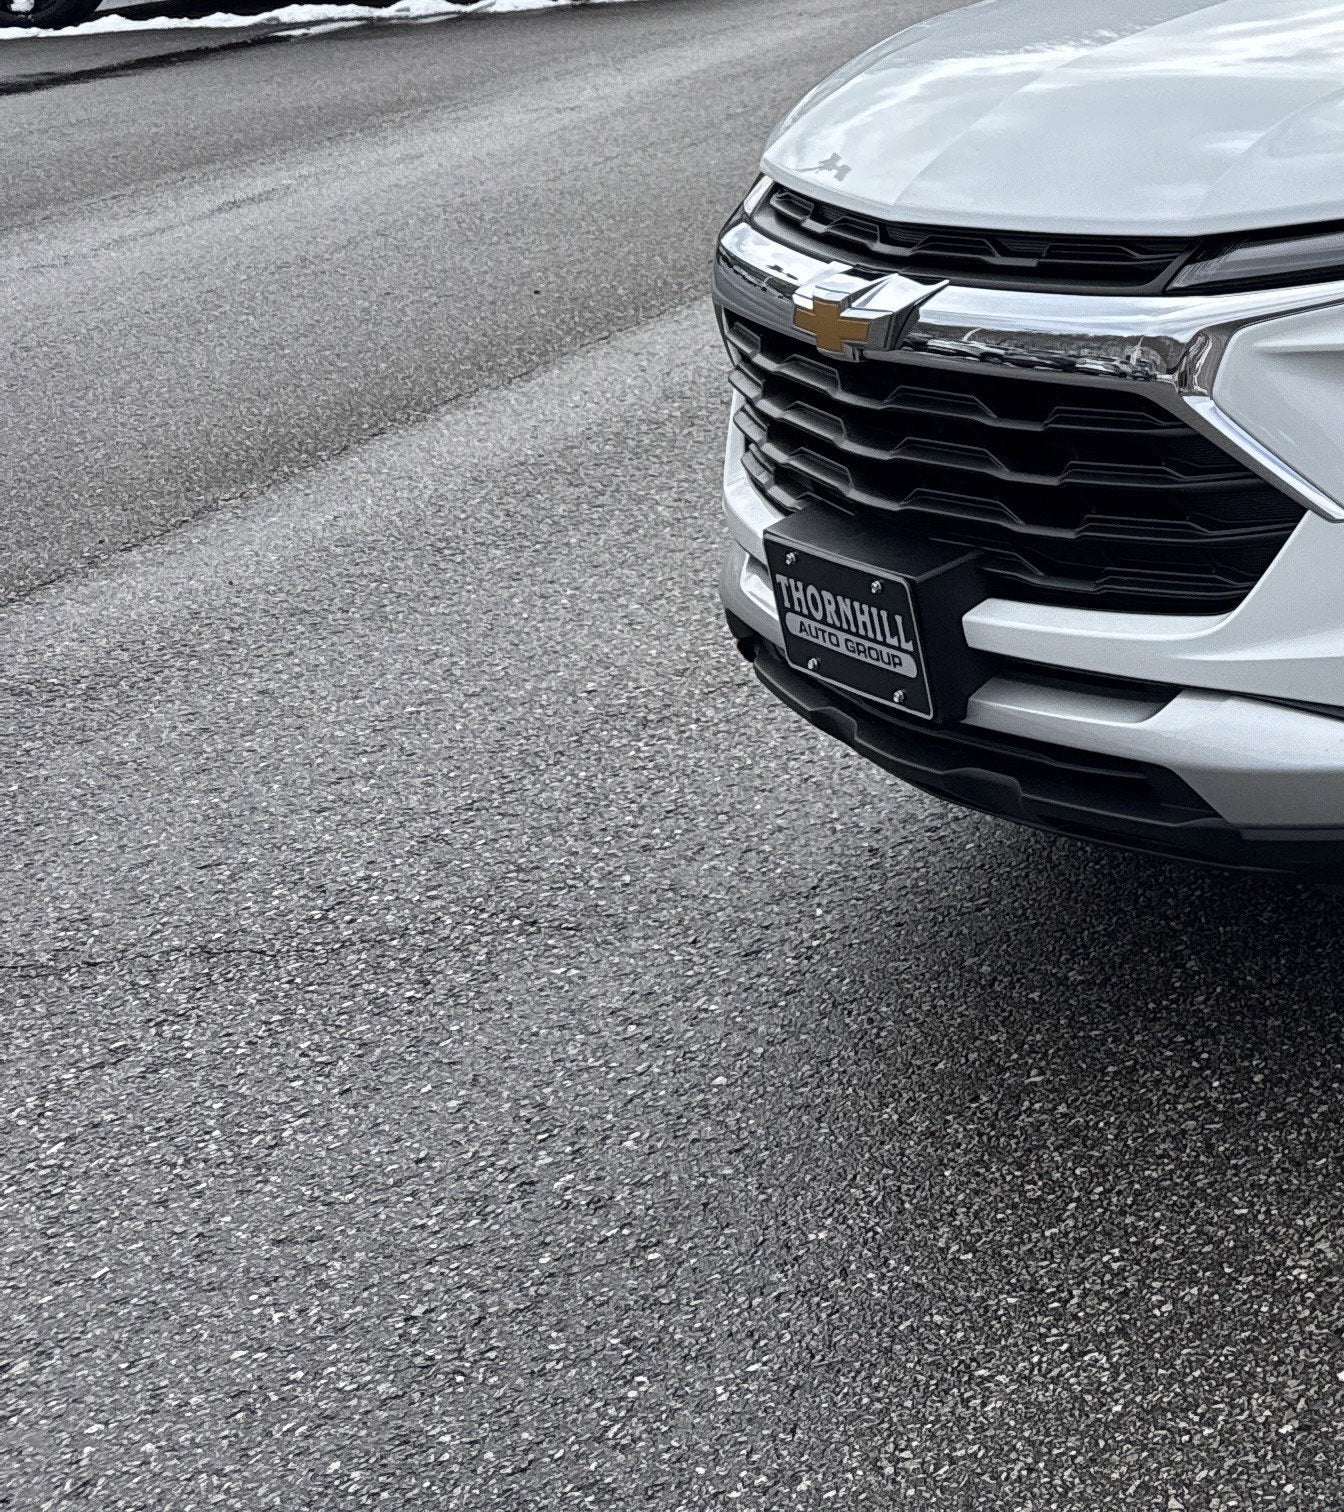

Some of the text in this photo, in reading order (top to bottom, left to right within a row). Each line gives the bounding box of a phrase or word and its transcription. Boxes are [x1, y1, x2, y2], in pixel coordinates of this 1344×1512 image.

[775, 573, 914, 653] THORNHILL
[798, 620, 903, 669] AUTO GROUP
